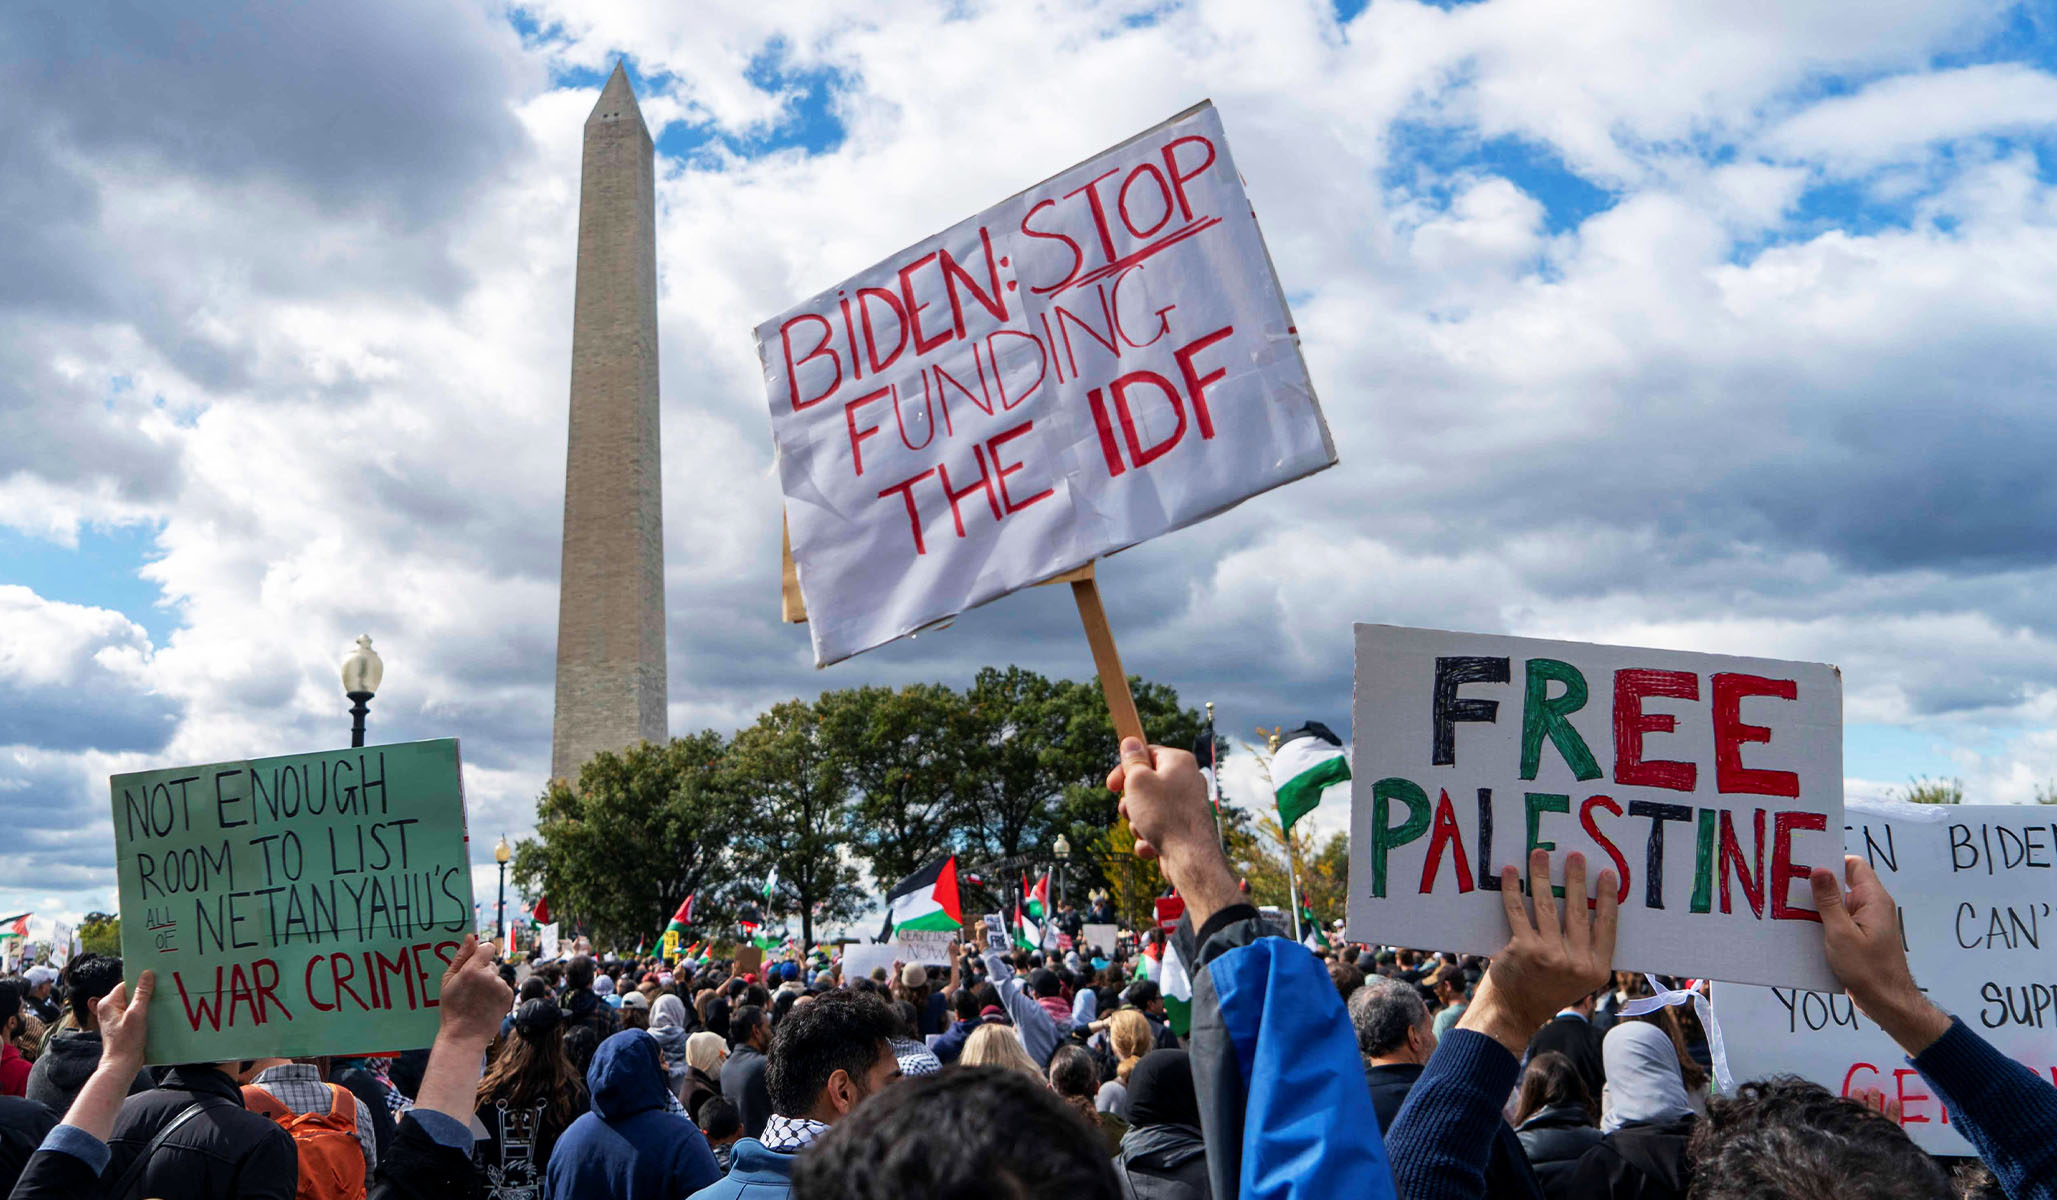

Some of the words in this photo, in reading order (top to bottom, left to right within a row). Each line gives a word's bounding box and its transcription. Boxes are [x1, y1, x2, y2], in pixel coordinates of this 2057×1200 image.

[1020, 134, 1217, 294] STOP
[845, 264, 1176, 477] FUNDING
[877, 420, 1055, 556] THE
[1087, 325, 1234, 477] IDF
[1432, 656, 1800, 798] FREE
[124, 776, 199, 842] NOT
[216, 752, 389, 828] ENOUGH
[139, 839, 233, 900] ROOM
[249, 831, 303, 887] TO
[329, 818, 419, 876] LIST
[1370, 776, 1828, 924] PALESTINE
[1949, 822, 2057, 876] BIDE
[146, 905, 177, 928] ALL
[155, 929, 177, 950] OF
[196, 864, 467, 955] NETANYAHU'S
[1956, 901, 2057, 950] CAN'
[173, 958, 293, 1032] WAR
